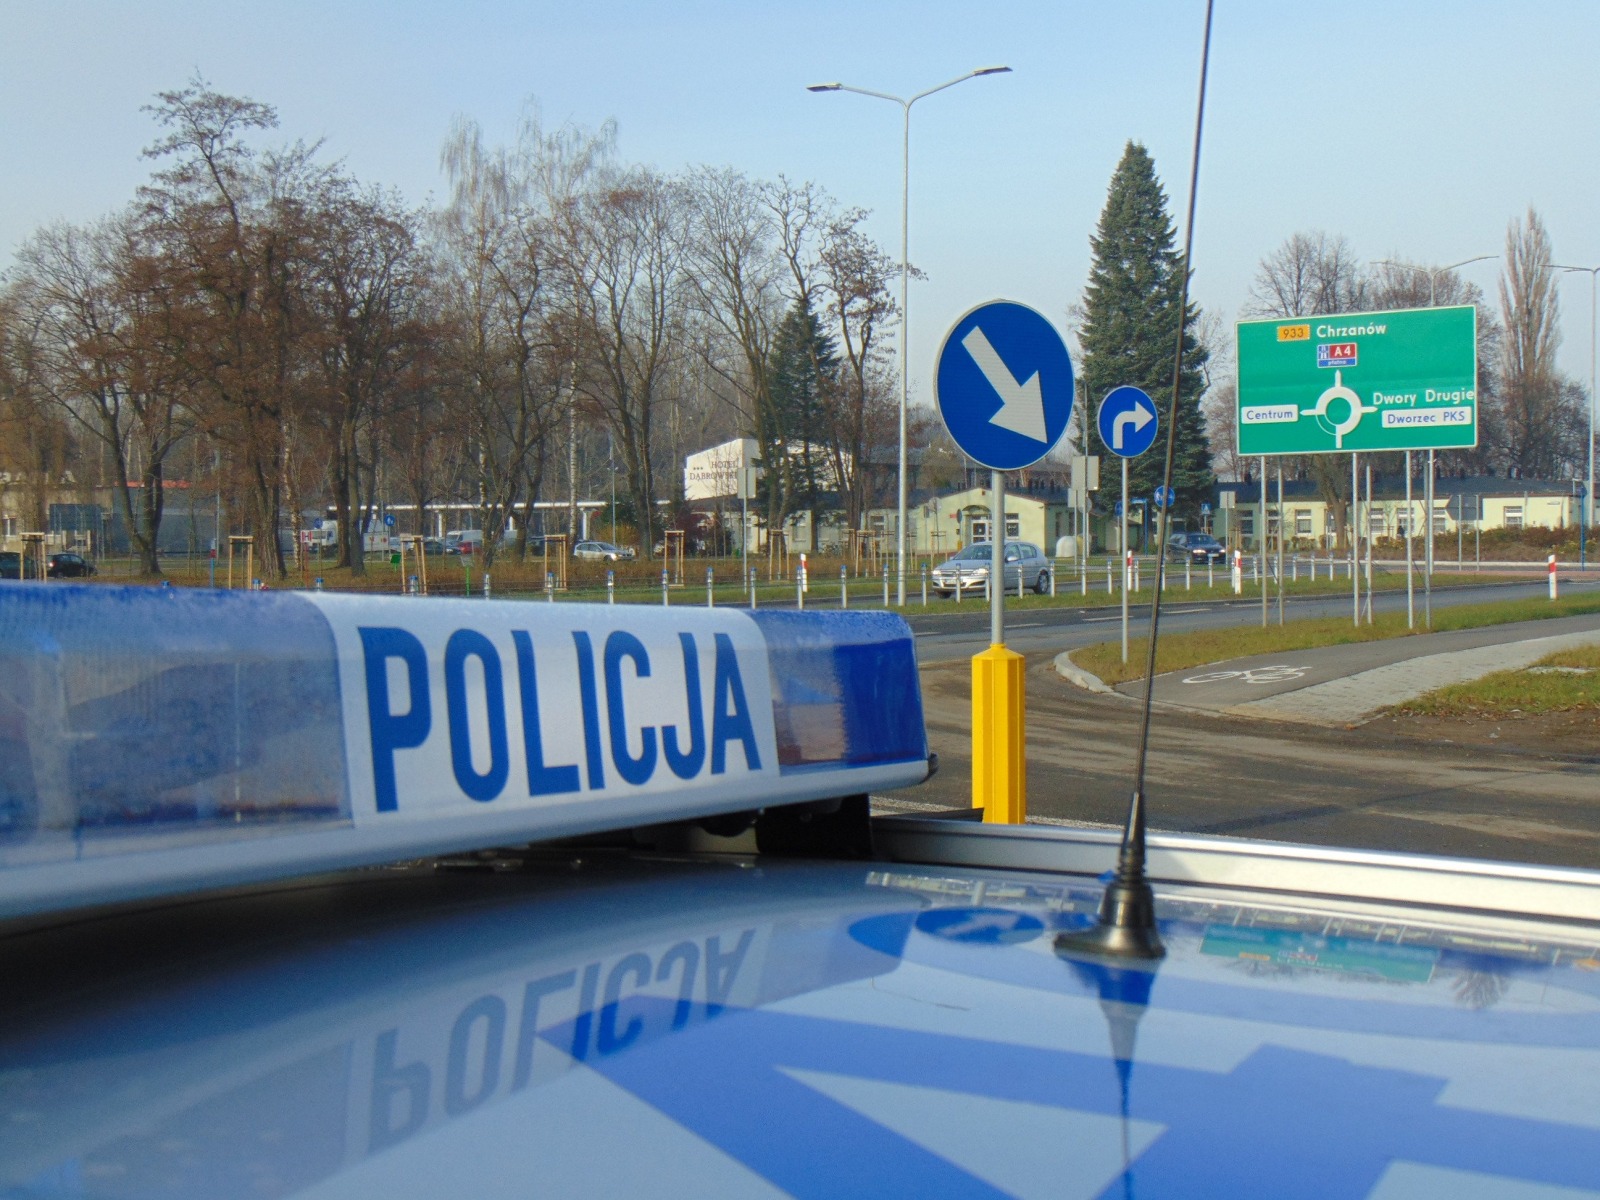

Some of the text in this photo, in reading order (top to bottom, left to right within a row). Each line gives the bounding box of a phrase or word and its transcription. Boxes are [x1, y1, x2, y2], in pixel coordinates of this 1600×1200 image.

[1283, 322, 1387, 339] 933 Chrzanów
[1373, 387, 1475, 407] Dwory Drugie
[1246, 410, 1293, 420] Centrum
[1387, 410, 1465, 424] Dworzec PKS
[711, 461, 738, 469] HOTEL
[357, 626, 762, 813] POLICJA
